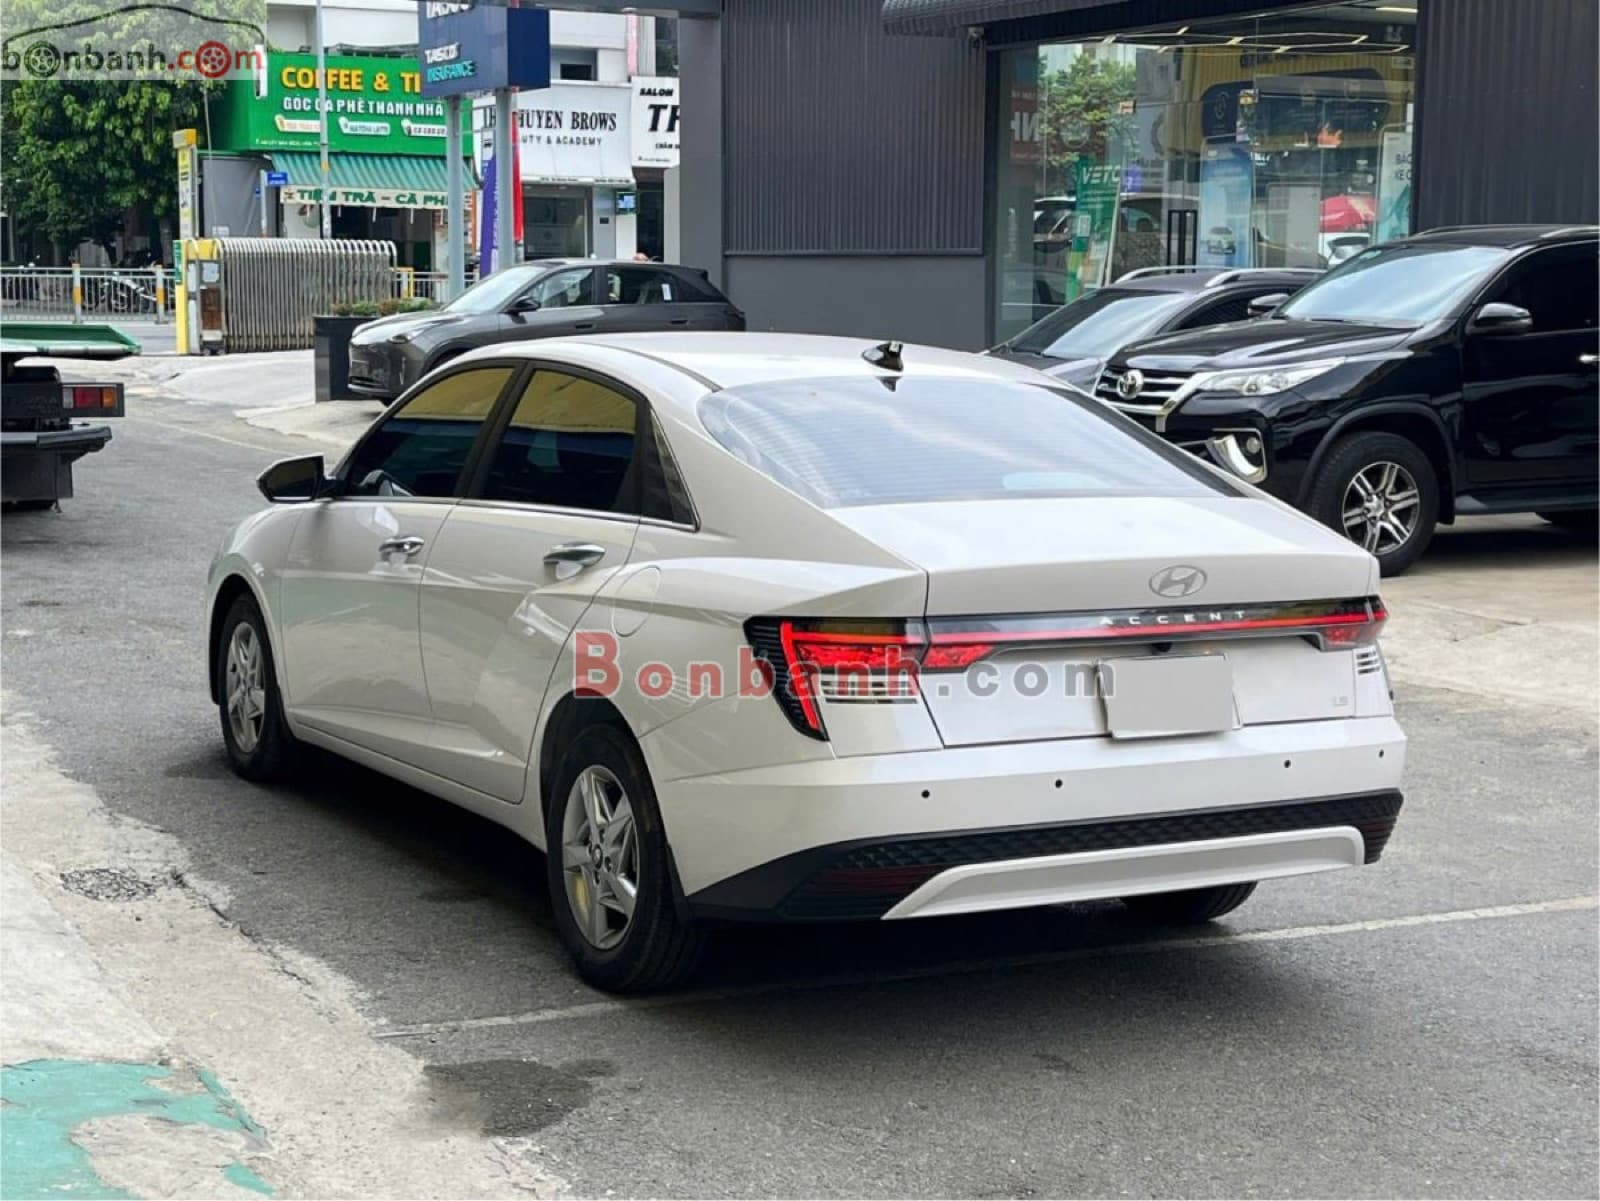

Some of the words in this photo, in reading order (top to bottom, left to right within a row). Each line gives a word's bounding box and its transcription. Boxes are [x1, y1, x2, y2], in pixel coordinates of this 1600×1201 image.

[425, 43, 460, 65] TASCO
[427, 60, 477, 82] INSURANCE
[373, 72, 390, 92] &
[640, 88, 674, 96] SALON
[367, 101, 414, 115] THANH
[571, 111, 617, 131] BROWS
[555, 136, 602, 147] ACADEMY
[1100, 609, 1246, 625] ACCENT
